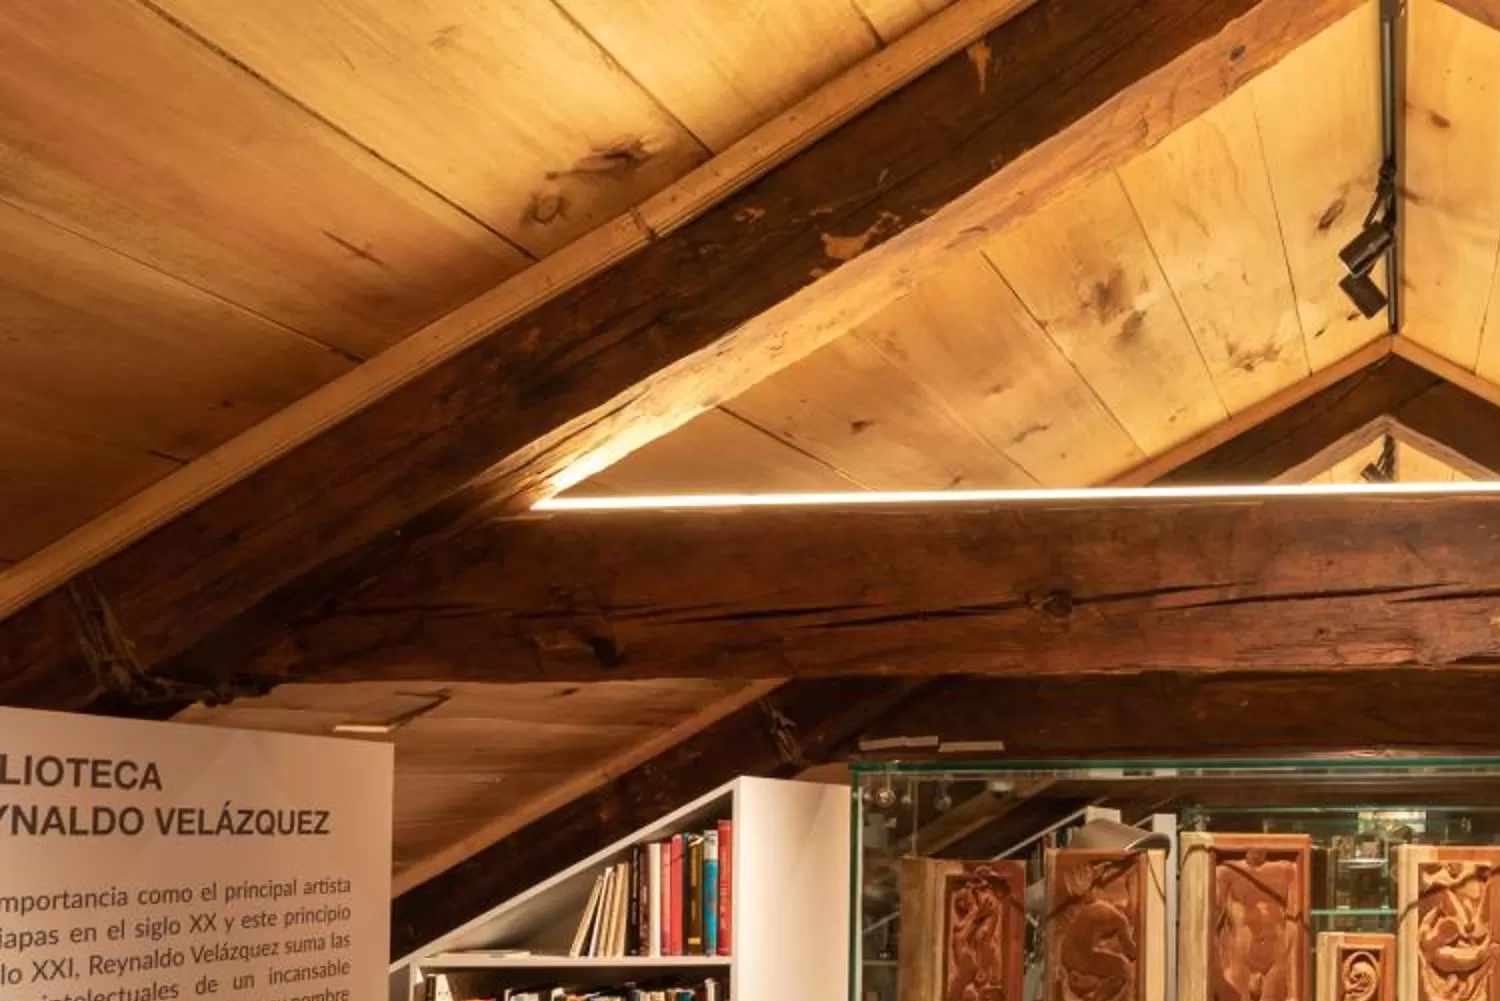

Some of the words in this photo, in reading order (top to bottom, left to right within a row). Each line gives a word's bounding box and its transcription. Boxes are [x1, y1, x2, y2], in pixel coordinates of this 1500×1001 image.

[0, 754, 163, 791] LIOTECA
[155, 801, 331, 837] VELÁZQUEZ
[136, 887, 193, 905] como
[199, 880, 217, 902] el
[224, 877, 297, 904] principal
[303, 876, 350, 895] artista
[69, 926, 97, 944] en
[106, 917, 125, 940] el
[133, 915, 181, 941] siglo
[188, 912, 216, 934] XX
[223, 915, 235, 936] y
[240, 910, 278, 928] este
[282, 903, 351, 928] principio
[89, 947, 185, 976] Reynaldo
[189, 941, 280, 964] Velázquez
[284, 936, 326, 955] suma
[330, 931, 351, 949] las
[194, 975, 220, 995] de
[232, 973, 255, 990] un
[267, 958, 351, 986] incansable
